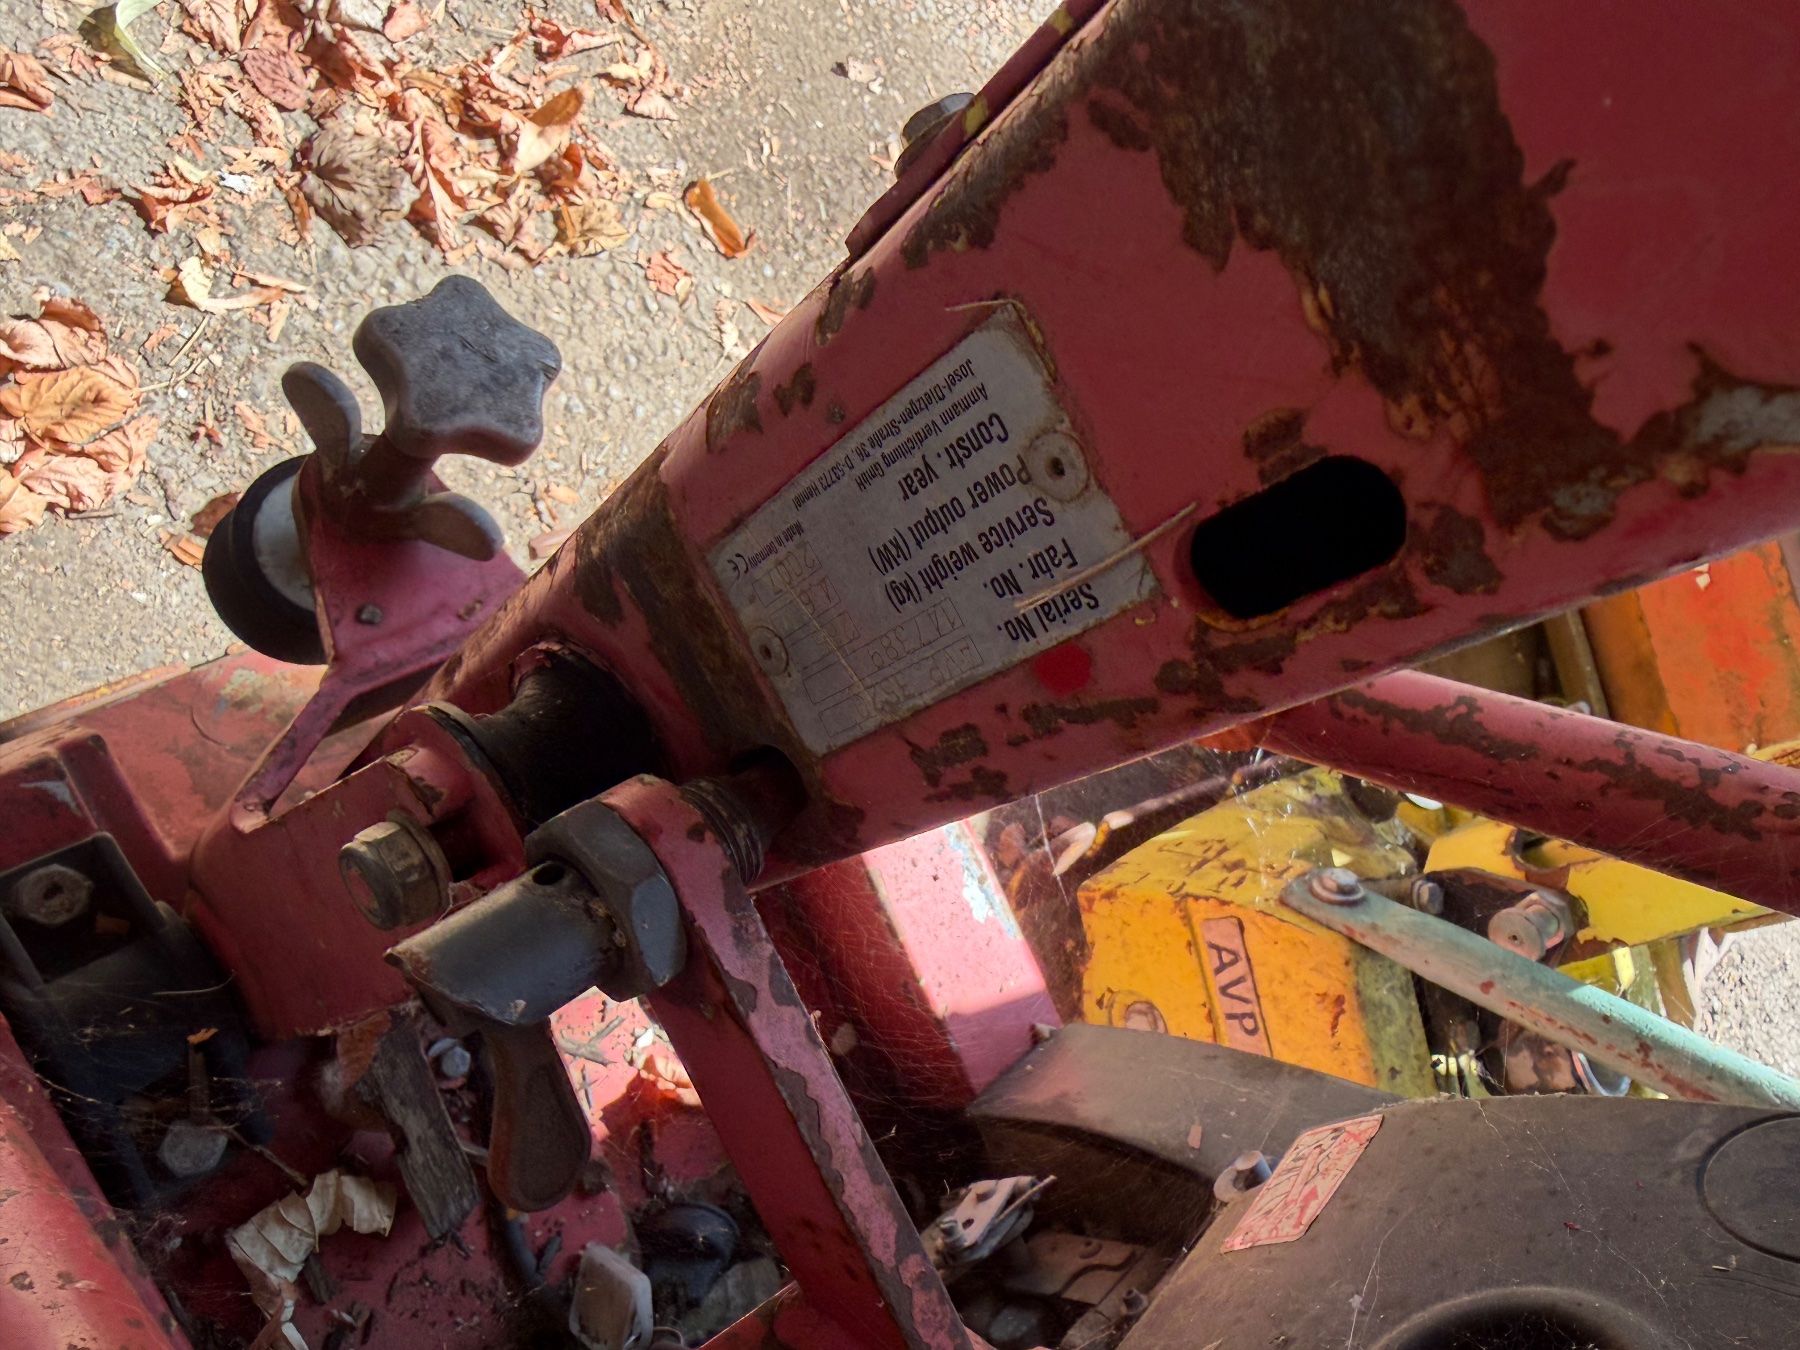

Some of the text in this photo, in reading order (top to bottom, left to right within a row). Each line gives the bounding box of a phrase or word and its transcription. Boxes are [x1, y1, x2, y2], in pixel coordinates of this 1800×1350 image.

[854, 381, 988, 492] Ammann Verdichtung GmbH
[897, 412, 1009, 502] Constr. year
[747, 540, 778, 568] Germany
[781, 519, 804, 542] Made
[867, 453, 1034, 576] Power output (kW)
[884, 496, 1055, 613] Service weight (kg)
[982, 536, 1078, 599] Fabr. No.
[996, 577, 1099, 642] Serial No.
[1206, 941, 1259, 1036] AVP
